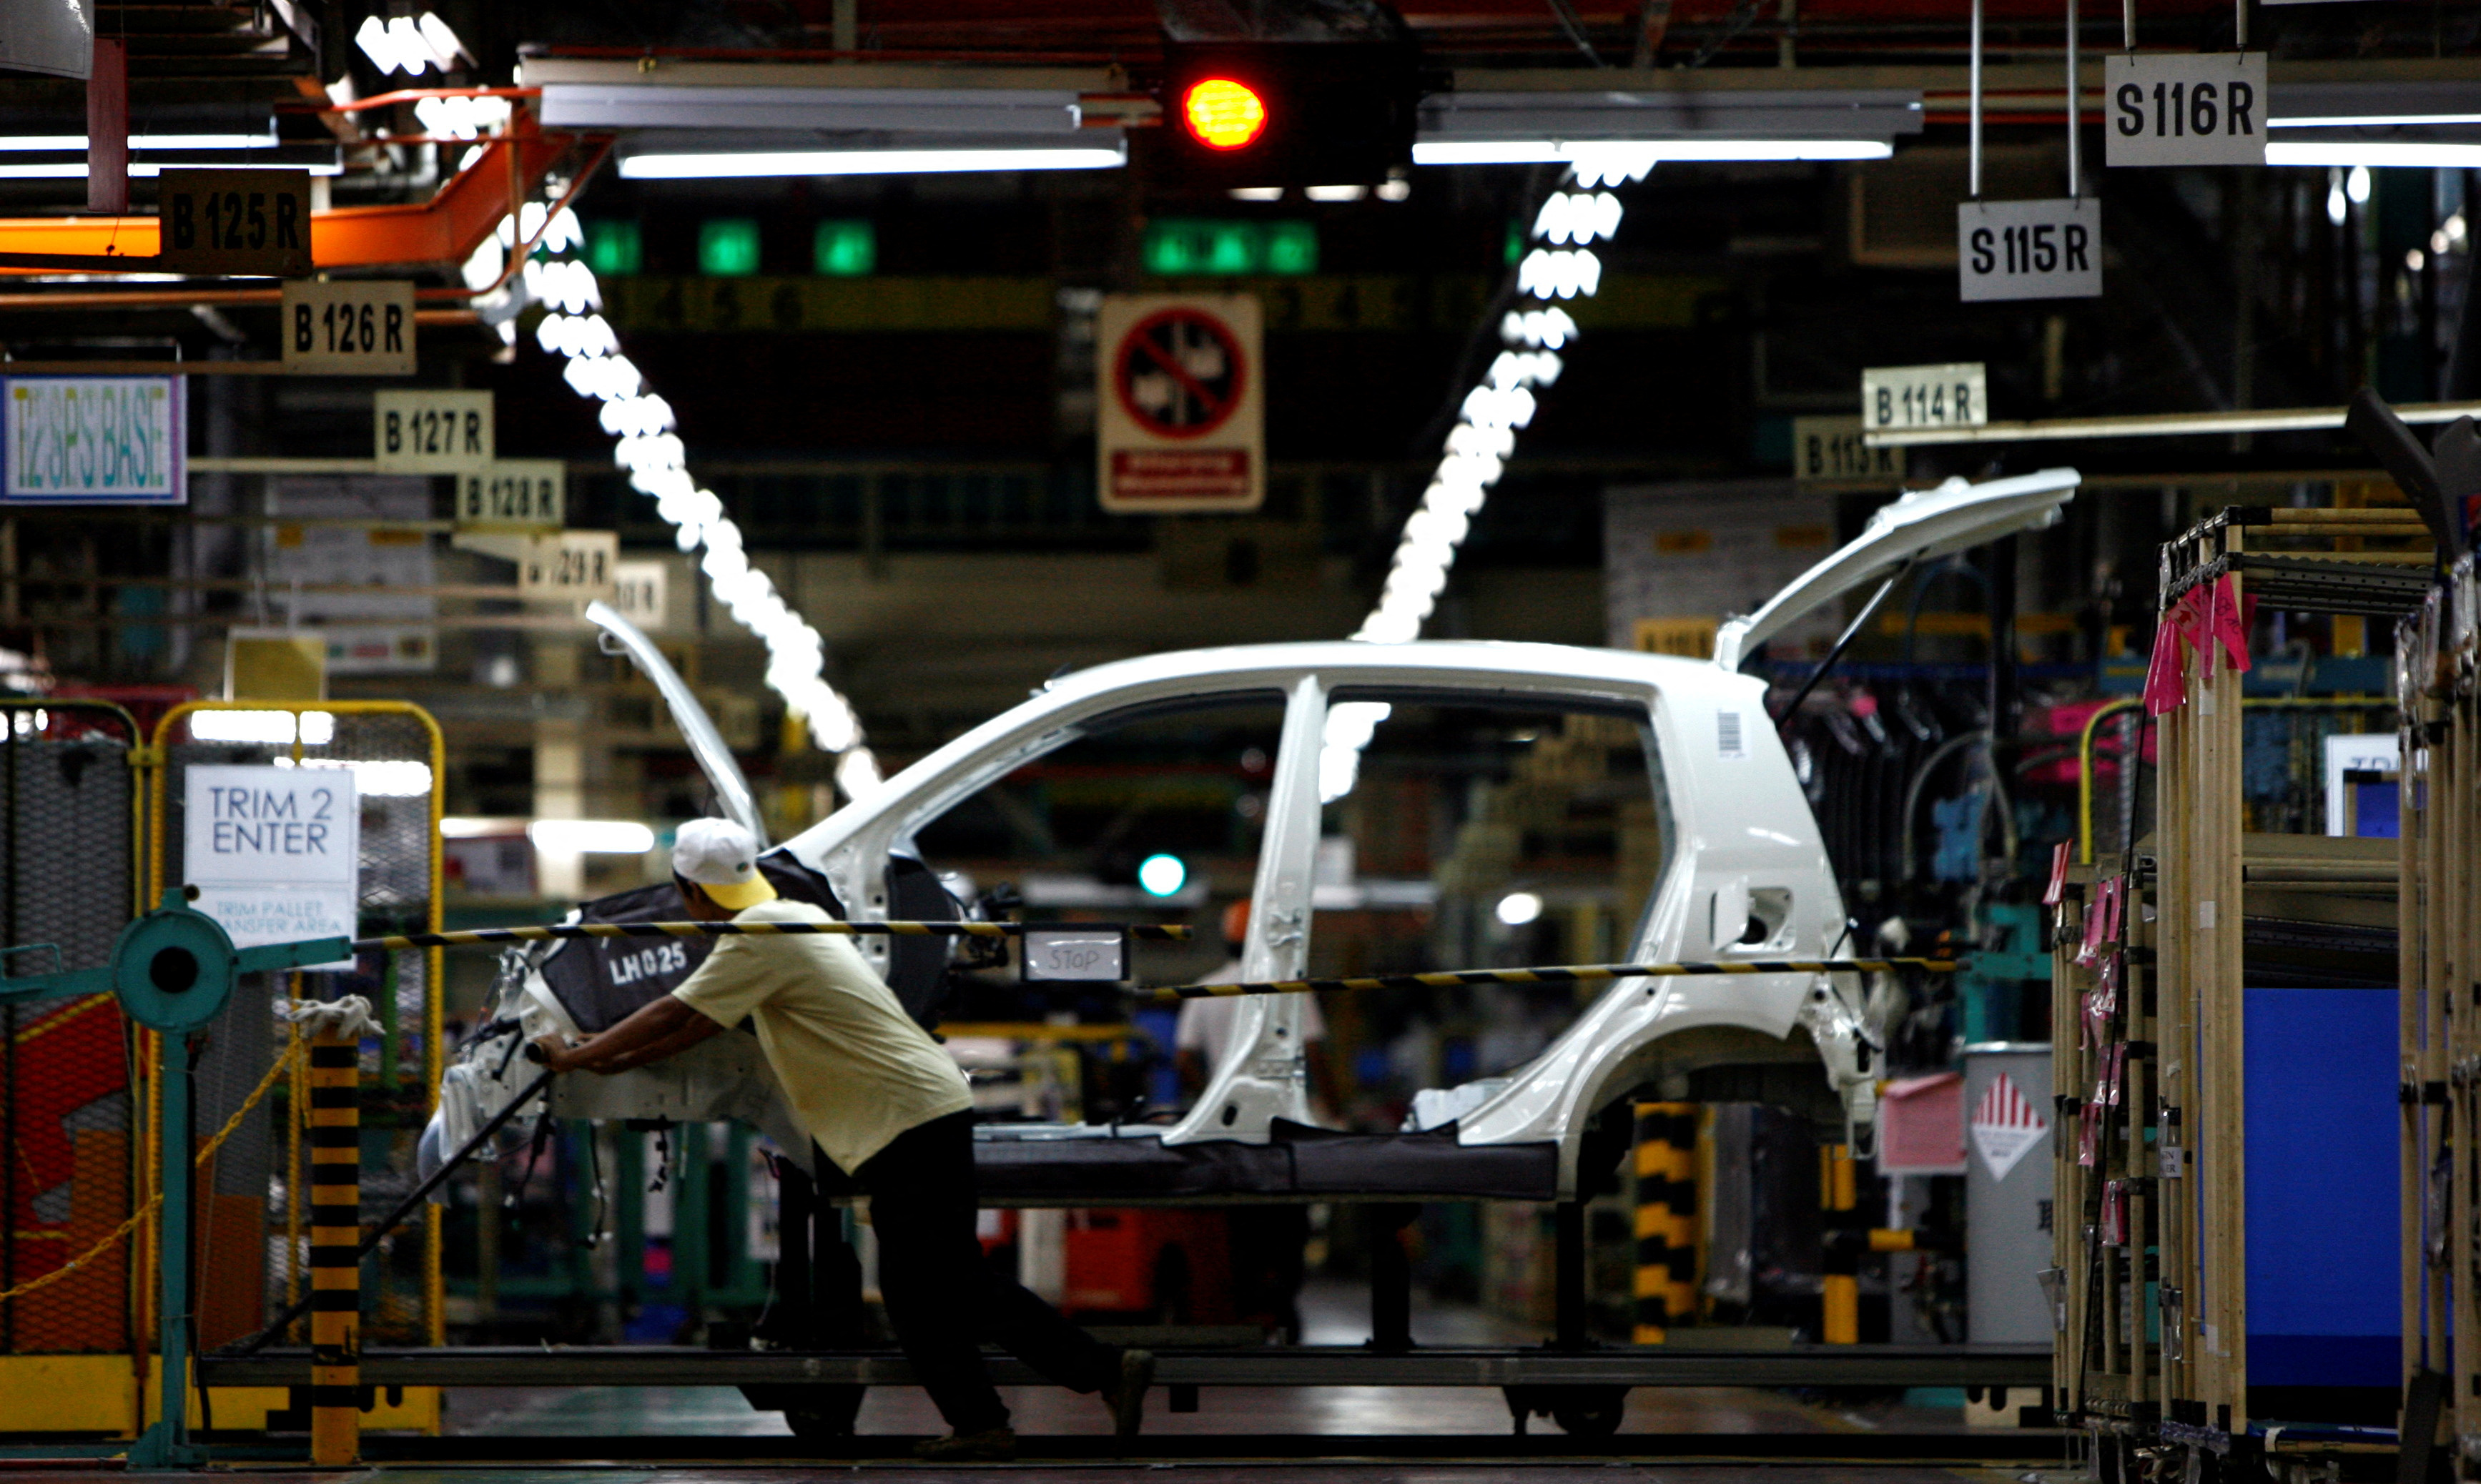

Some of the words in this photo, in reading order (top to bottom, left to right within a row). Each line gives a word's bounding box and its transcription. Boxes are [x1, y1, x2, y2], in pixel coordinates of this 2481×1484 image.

[209, 787, 297, 819] TRIM
[310, 787, 333, 821] 2
[213, 821, 329, 854] ENTER
[217, 901, 257, 916] TRIM
